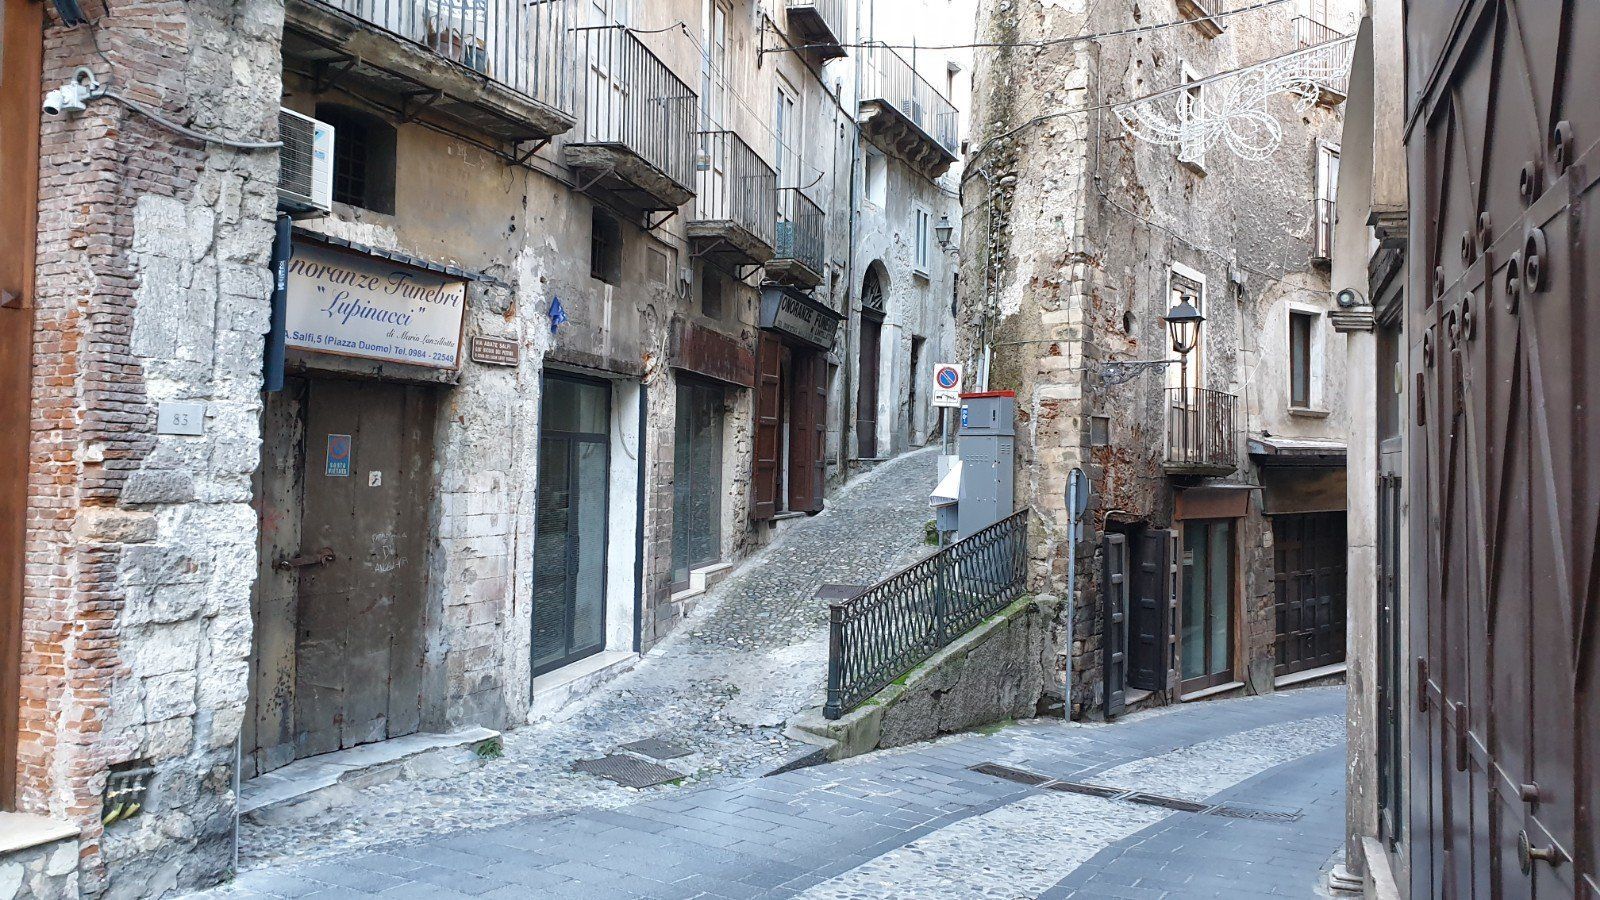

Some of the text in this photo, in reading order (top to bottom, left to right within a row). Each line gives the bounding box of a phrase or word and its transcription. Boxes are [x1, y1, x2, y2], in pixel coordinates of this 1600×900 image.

[288, 258, 379, 291] noranze
[384, 271, 464, 308] Funebri
[781, 296, 813, 324] ONORANZE
[386, 328, 395, 338] di
[324, 334, 357, 349] (Piazza
[358, 340, 392, 354] Duomo)
[432, 352, 455, 363] 22549
[172, 413, 188, 426] 83
